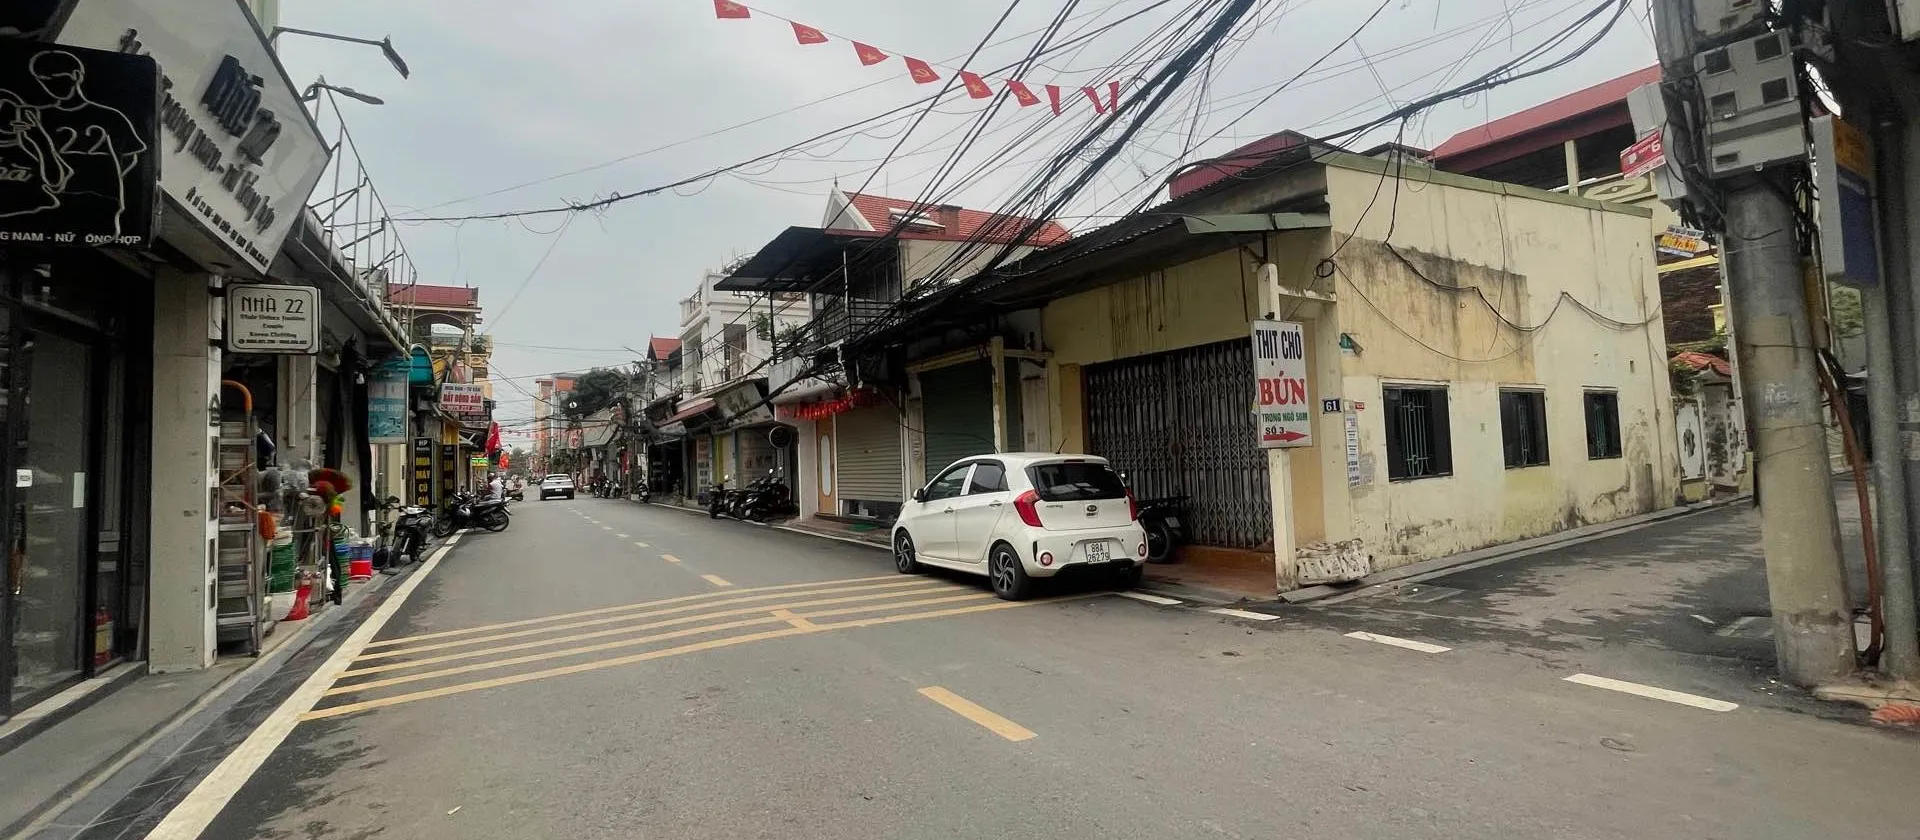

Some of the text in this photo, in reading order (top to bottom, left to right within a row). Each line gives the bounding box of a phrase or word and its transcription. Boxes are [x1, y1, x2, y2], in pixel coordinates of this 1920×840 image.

[12, 231, 44, 242] NAM
[55, 231, 76, 242] NỮ
[241, 294, 304, 314] NHÀ 22
[1256, 325, 1303, 366] THỊT CHÓ
[1258, 370, 1306, 406] BÚN
[1325, 401, 1338, 412] 61
[1279, 426, 1285, 434] 3
